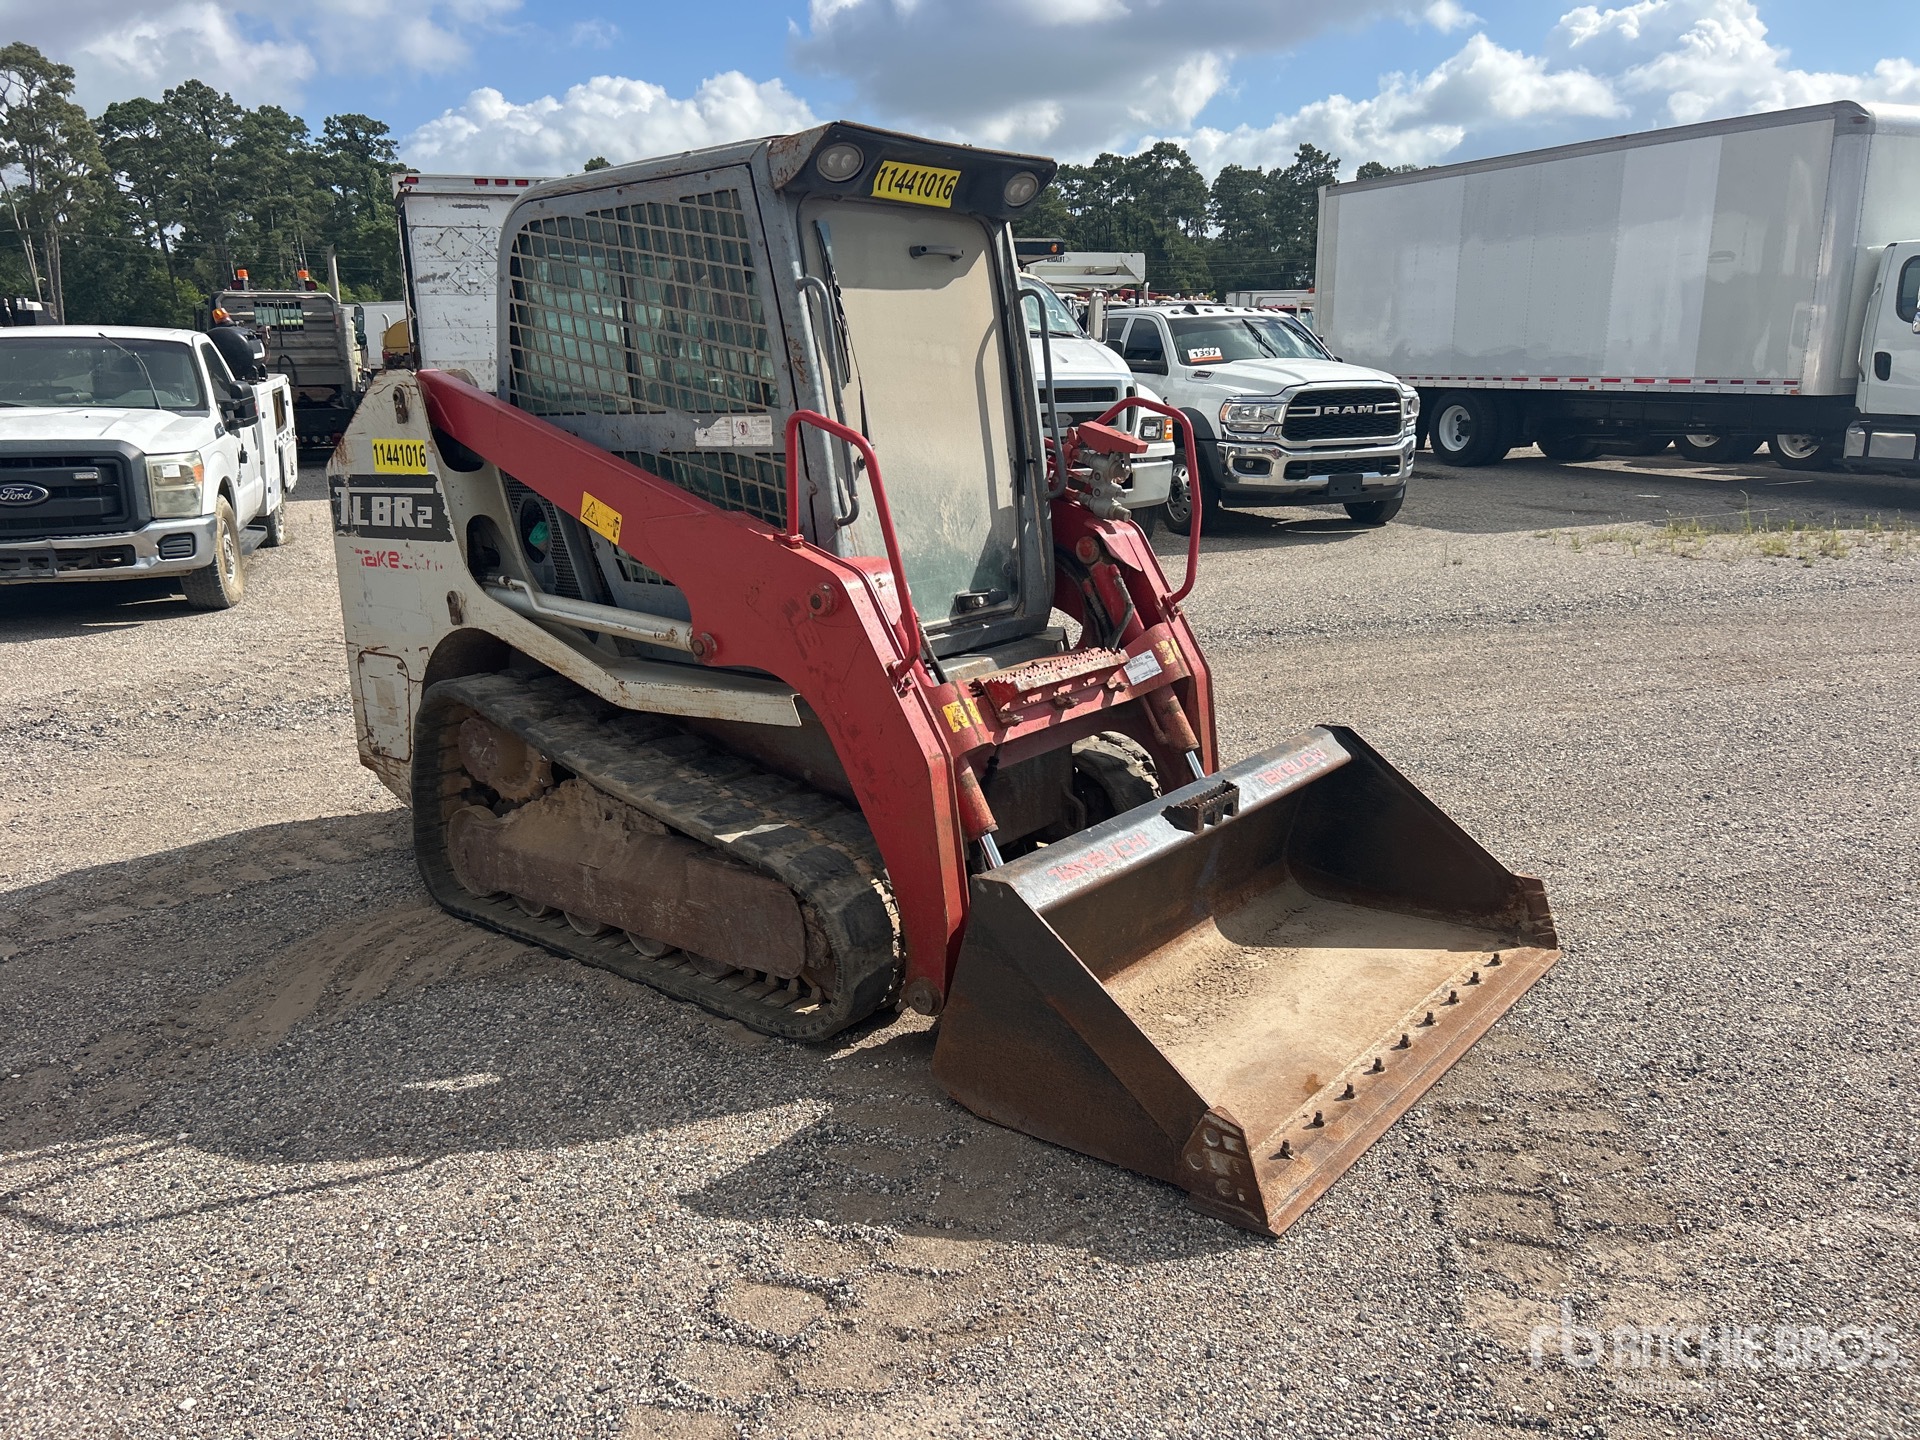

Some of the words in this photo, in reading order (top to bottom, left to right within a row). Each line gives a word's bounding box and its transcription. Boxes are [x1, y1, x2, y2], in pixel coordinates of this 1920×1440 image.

[877, 165, 958, 200] 11441016
[1323, 404, 1374, 415] RAM
[373, 443, 427, 468] 11441016
[0, 487, 33, 500] Ford
